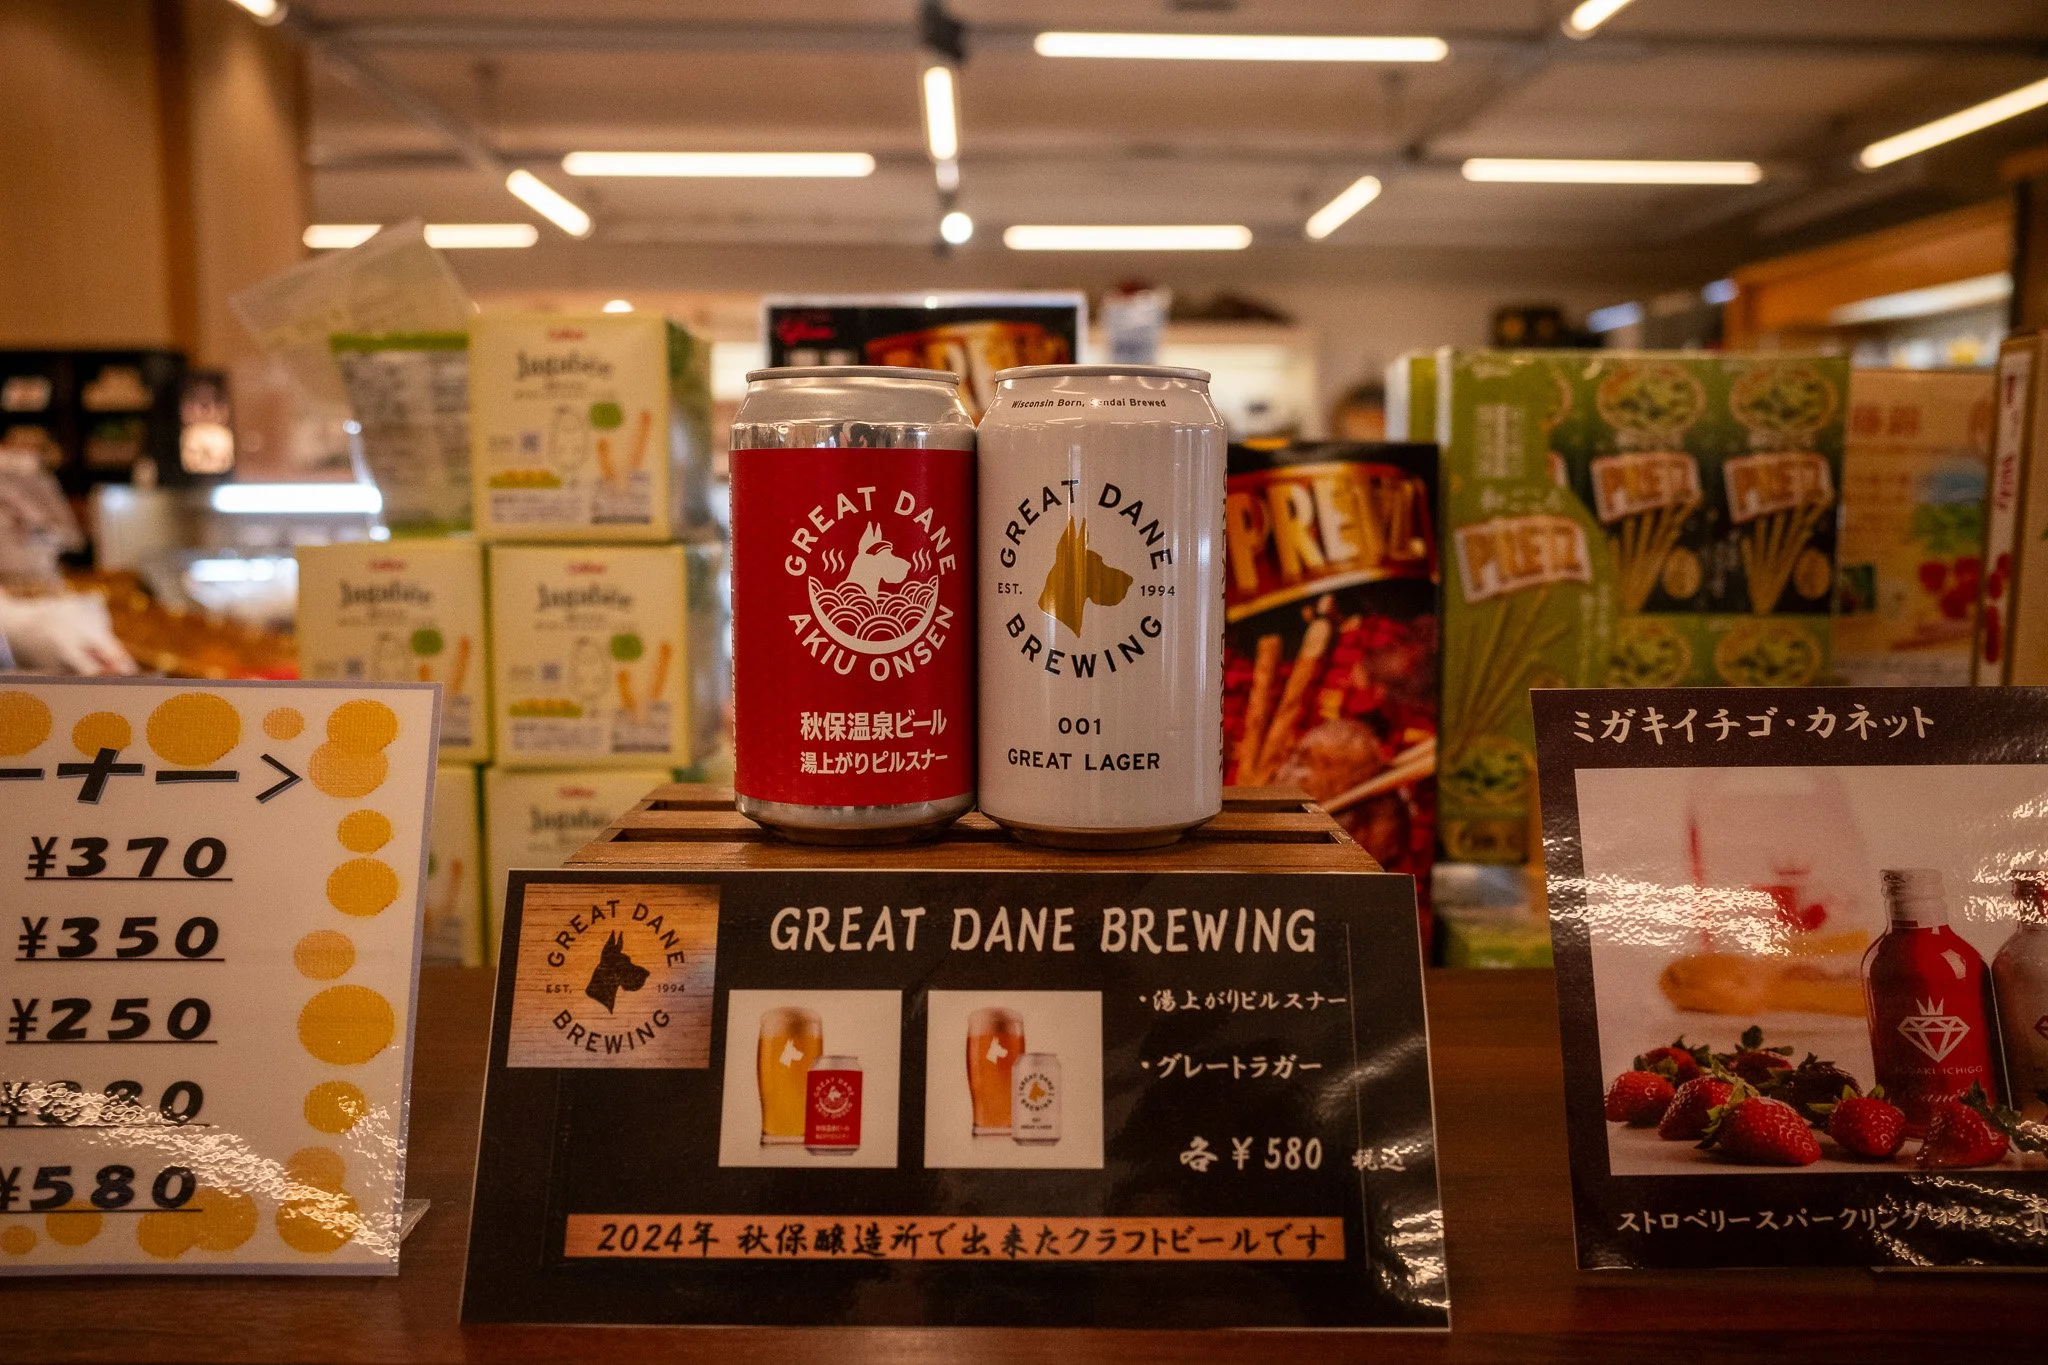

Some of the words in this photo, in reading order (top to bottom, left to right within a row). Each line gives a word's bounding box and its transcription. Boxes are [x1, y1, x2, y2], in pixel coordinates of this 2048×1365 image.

[1011, 398, 1053, 409] Wisconsin
[1057, 398, 1085, 407] Born,
[1129, 398, 1167, 408] Brewed
[785, 486, 877, 576] GREAT
[894, 489, 957, 576] DANE
[1000, 479, 1080, 568] GREAT
[1098, 483, 1173, 570] DANE
[997, 582, 1023, 595] EST.
[1140, 585, 1176, 597] 1994
[788, 613, 857, 676] AKIU
[869, 603, 954, 682] ONSEN
[1006, 613, 1162, 678] BREWING
[800, 709, 948, 742] 秋保温泉ビール
[1058, 717, 1101, 735] 001
[1573, 703, 1935, 746] ミガキイチゴ・カネット
[800, 748, 948, 775] 湯上がりピルスナー
[1008, 748, 1073, 770] GREAT
[1085, 752, 1161, 771] LAGER
[28, 836, 227, 877] ¥370
[18, 916, 220, 959] ¥350
[547, 899, 620, 968] GREAT
[632, 903, 686, 967] DANE
[769, 905, 927, 953] GREAT
[950, 905, 1076, 953] DANE
[1100, 906, 1316, 954] BREWING
[657, 983, 686, 994] 1994
[8, 997, 212, 1041] ¥250
[552, 1009, 670, 1055] BREWING
[0, 1164, 197, 1210] ¥580
